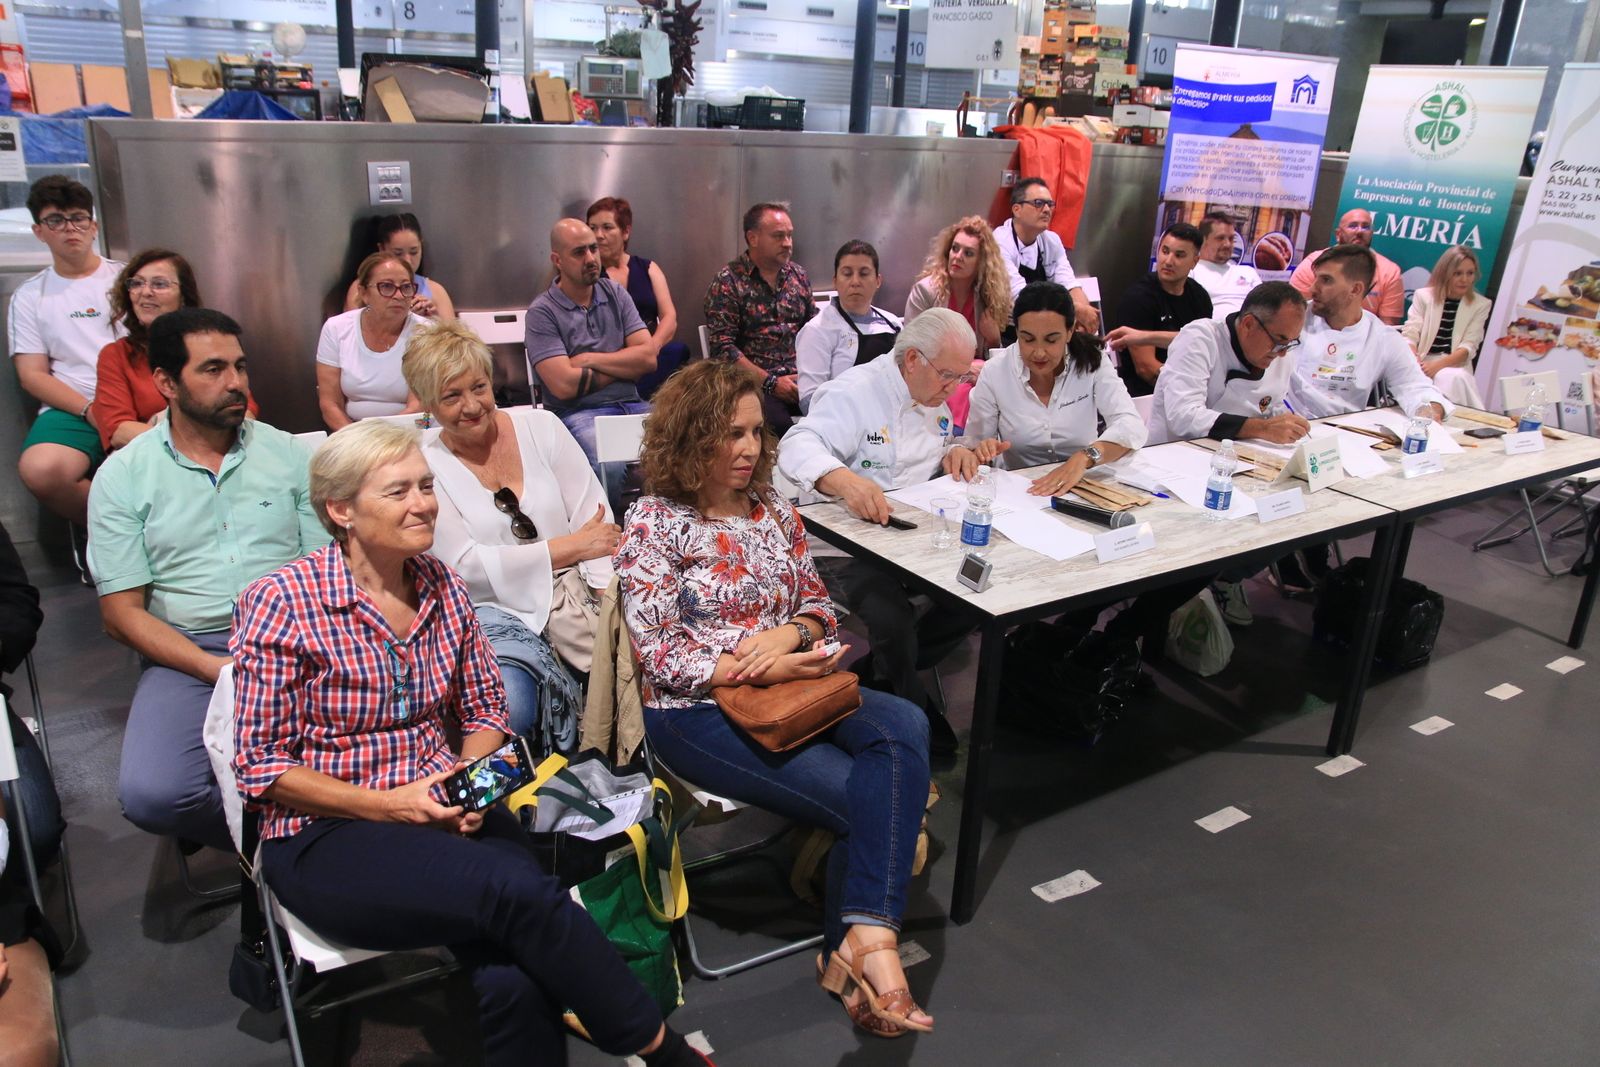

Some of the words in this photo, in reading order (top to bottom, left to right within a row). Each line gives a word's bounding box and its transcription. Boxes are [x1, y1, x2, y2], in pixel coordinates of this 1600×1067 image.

[404, 0, 416, 20] 8
[909, 41, 924, 57] 10
[1152, 47, 1167, 66] 10
[1173, 86, 1212, 100] Entregamos
[1212, 93, 1233, 103] gratis
[1233, 95, 1245, 103] tus
[1245, 94, 1273, 104] pedidos
[1434, 80, 1466, 95] ASHAL
[1550, 160, 1600, 175] Campeo
[1357, 175, 1369, 186] La
[1371, 177, 1423, 191] Asociación
[1425, 182, 1480, 198] Provincial
[1482, 188, 1497, 199] de
[1547, 175, 1589, 188] ASHAL
[1354, 189, 1413, 205] Empresarios
[1418, 196, 1432, 207] de
[1437, 198, 1492, 215] Hostelería
[1559, 191, 1571, 200] 22
[1572, 193, 1578, 202] y
[1580, 192, 1593, 202] 25
[1558, 201, 1577, 209] INFO
[1539, 209, 1596, 220] www.ashal.es
[1368, 210, 1483, 249] LMERÍA
